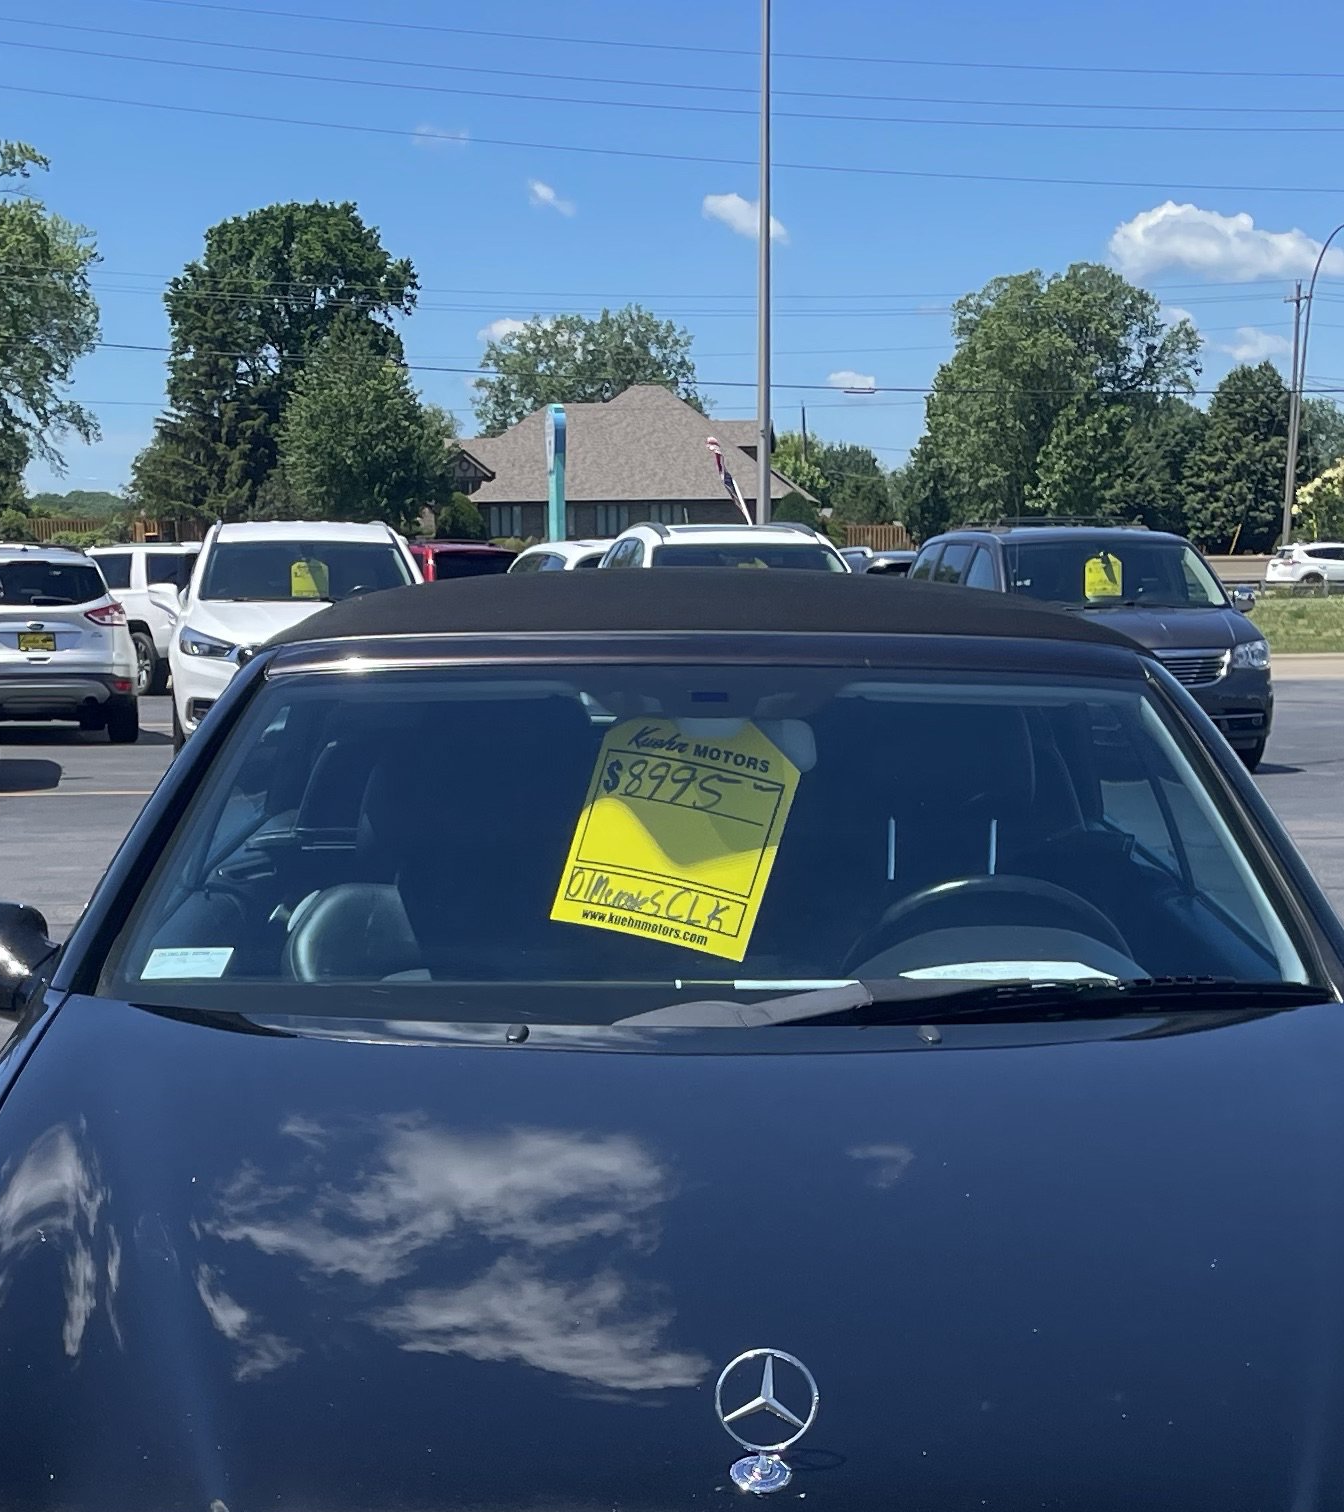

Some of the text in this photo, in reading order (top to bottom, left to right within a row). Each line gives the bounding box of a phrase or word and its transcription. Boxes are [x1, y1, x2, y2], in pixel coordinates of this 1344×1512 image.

[627, 726, 771, 773] Kuehn MOTORS
[582, 908, 708, 946] www.kuehnmotors.com
